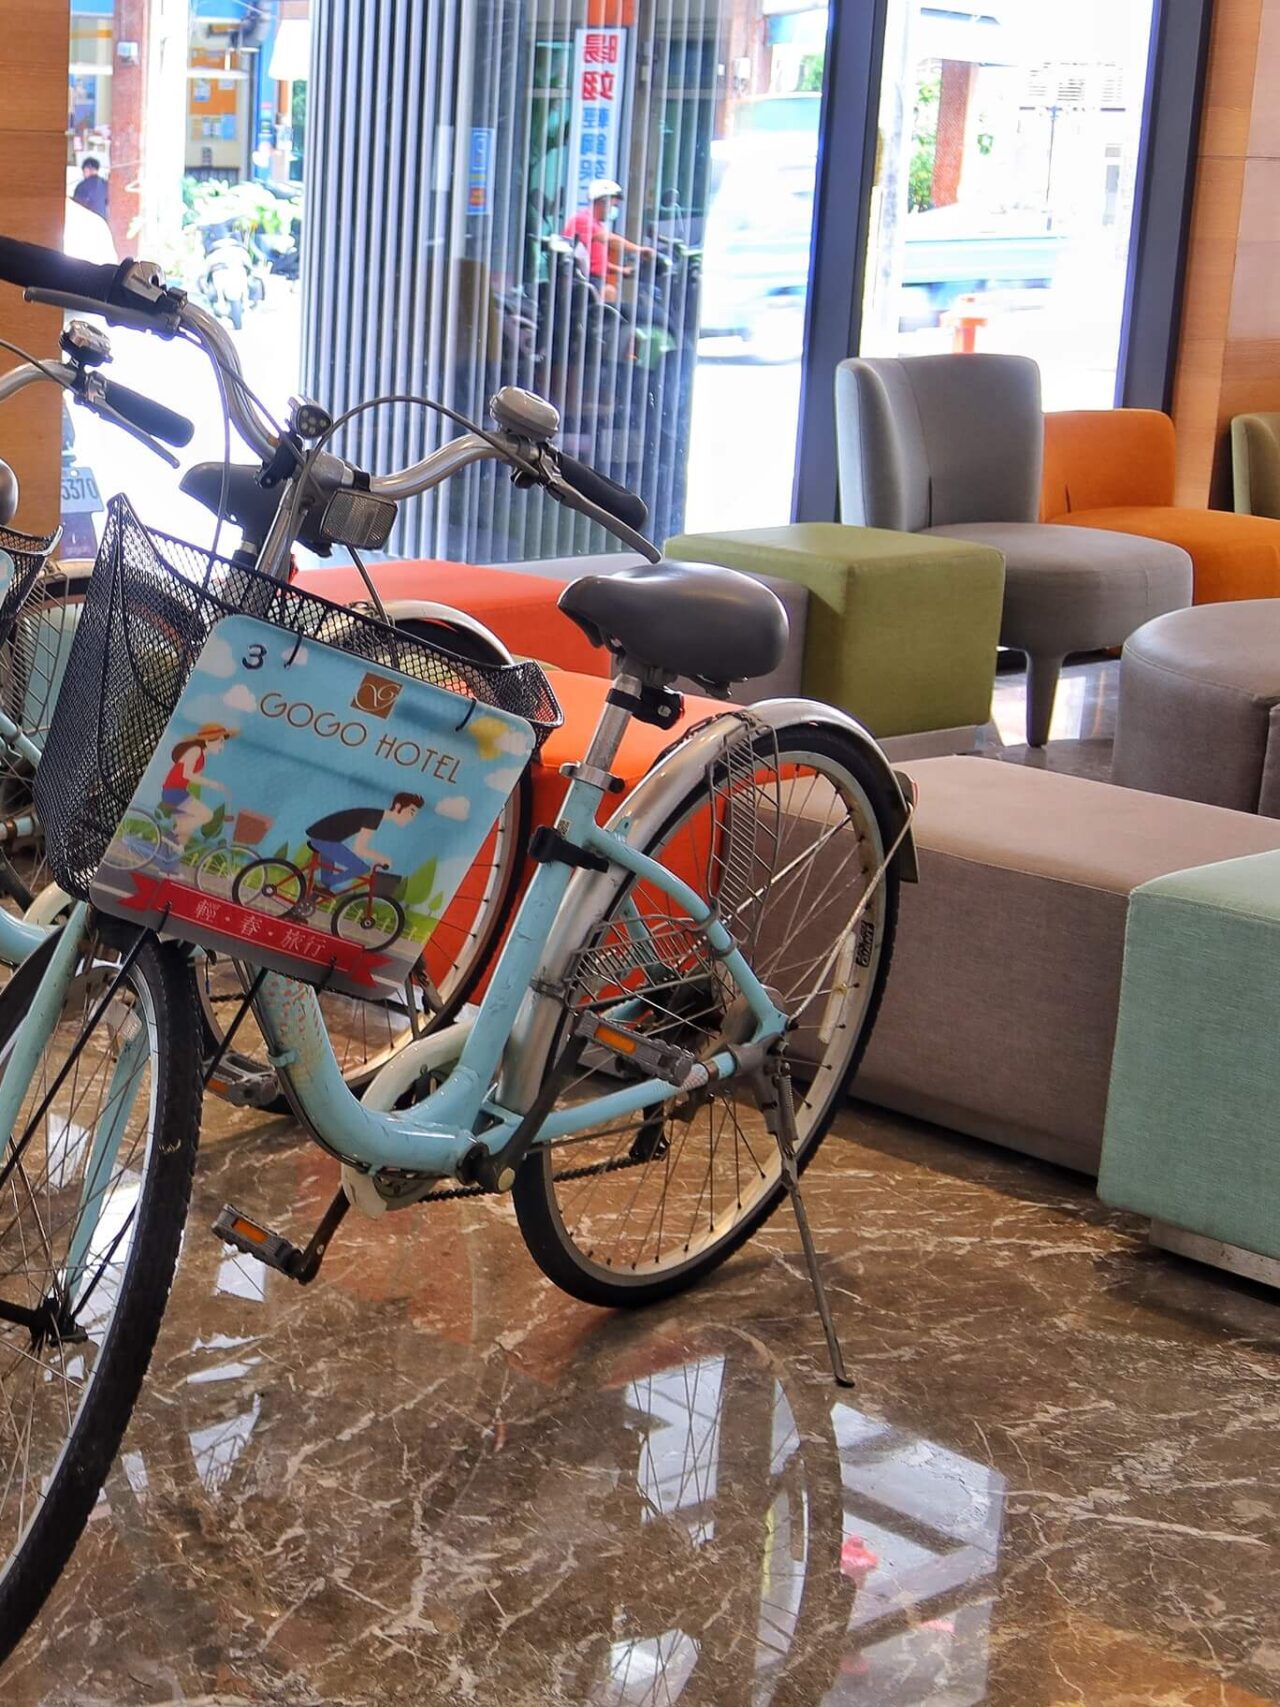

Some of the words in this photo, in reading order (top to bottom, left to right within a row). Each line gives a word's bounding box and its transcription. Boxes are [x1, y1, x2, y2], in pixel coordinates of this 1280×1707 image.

[242, 644, 267, 669] 3
[260, 692, 367, 747] GOGO
[374, 733, 462, 784] HOTEL
